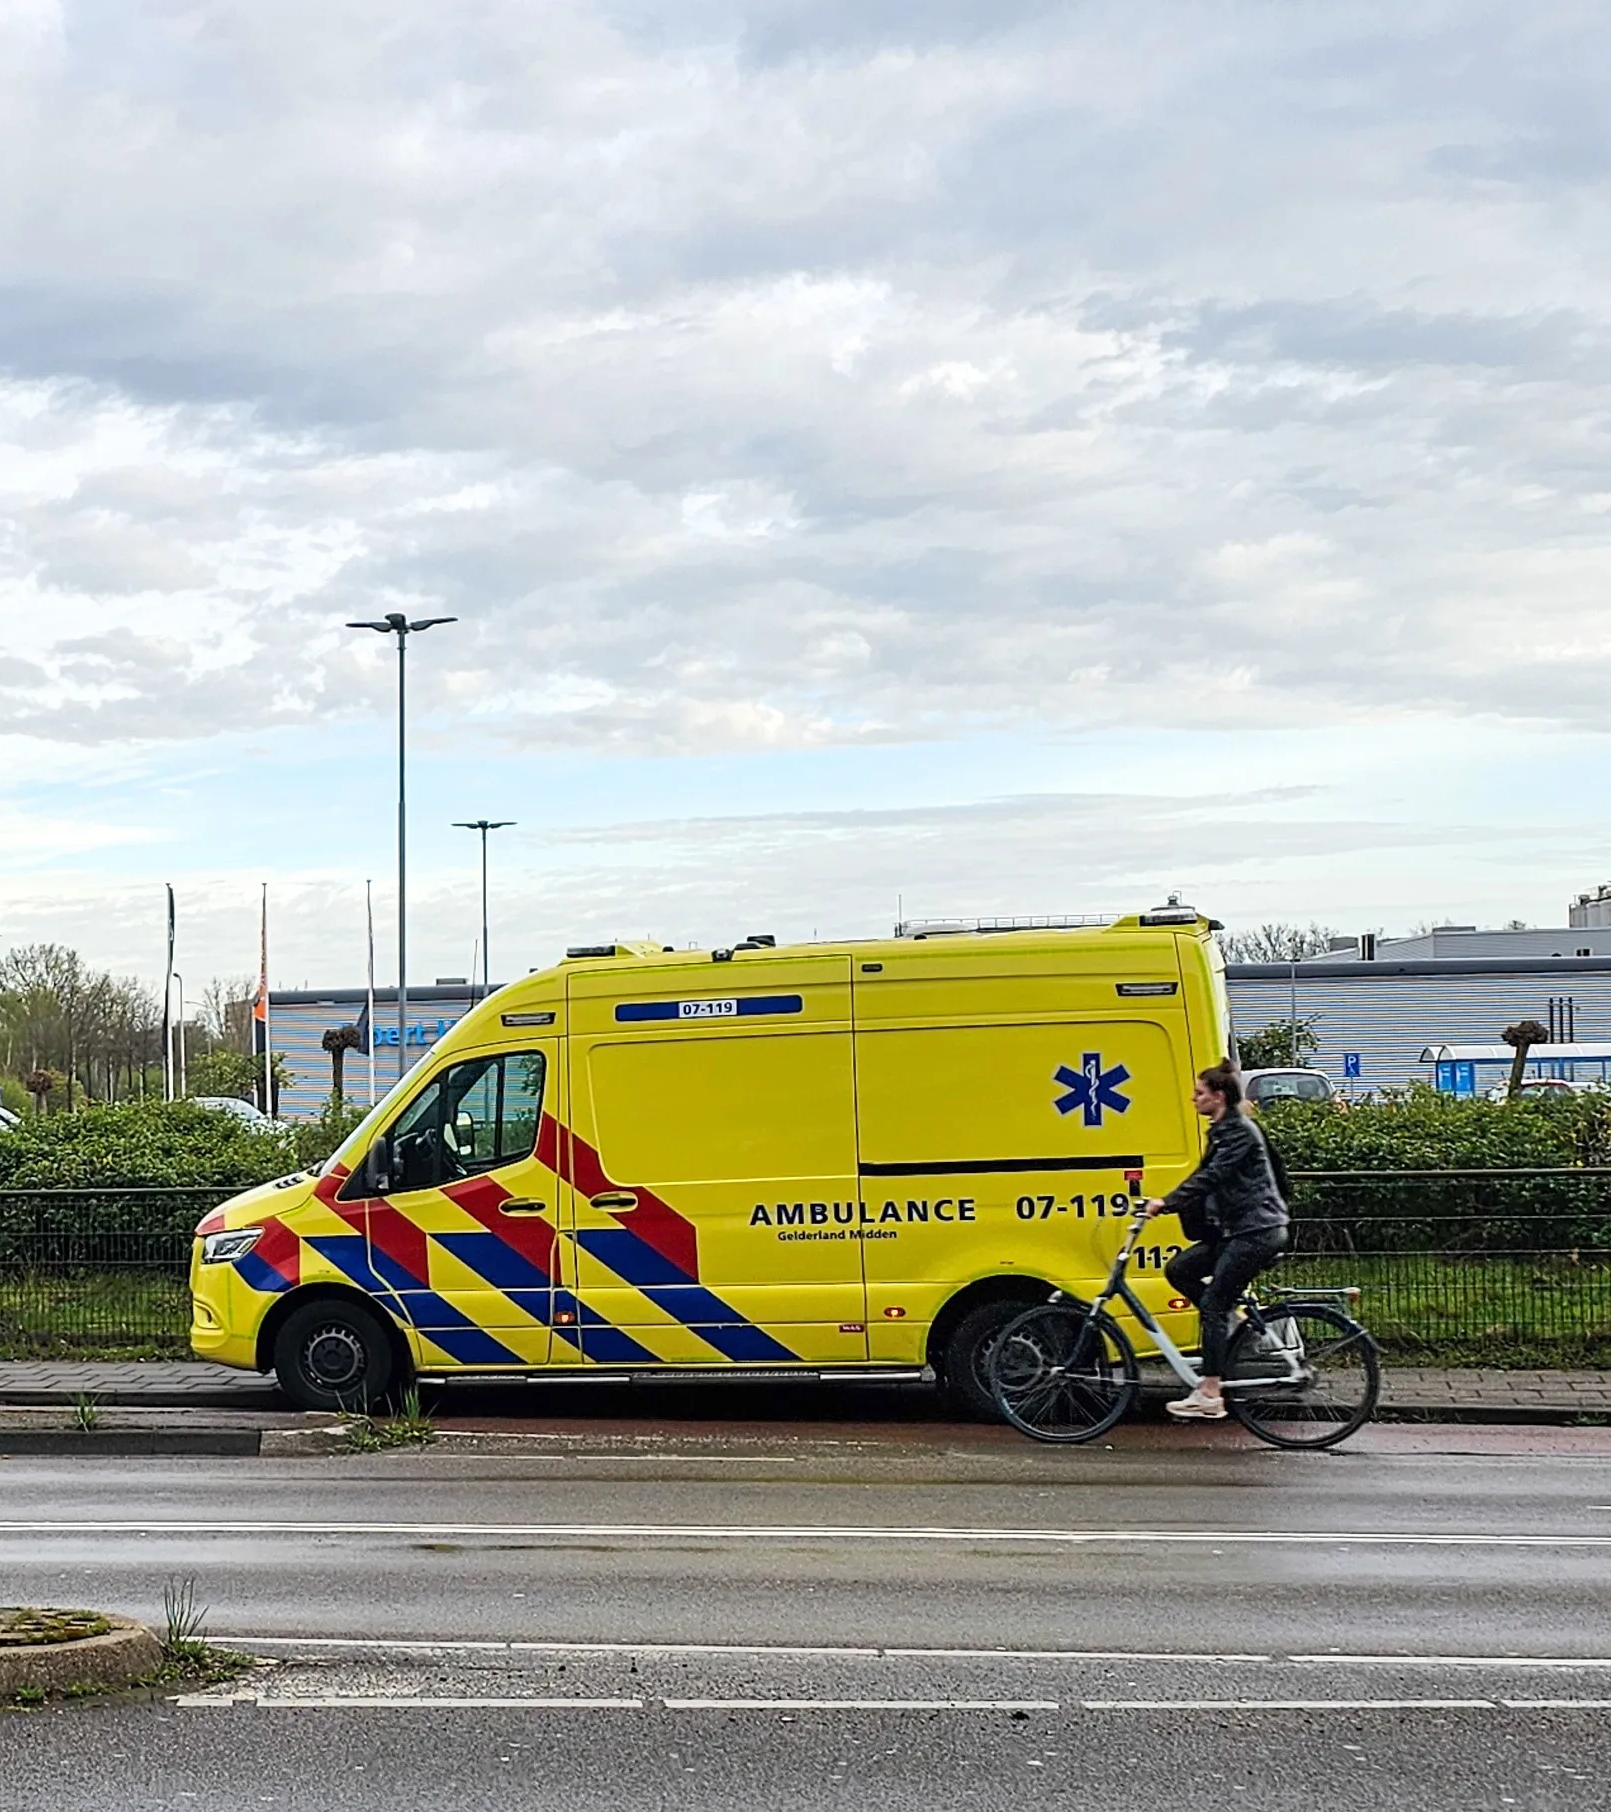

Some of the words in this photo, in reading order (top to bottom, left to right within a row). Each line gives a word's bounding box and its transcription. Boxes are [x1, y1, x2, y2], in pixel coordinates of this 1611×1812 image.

[682, 1001, 733, 1015] 07-119
[750, 1199, 976, 1226] AMBULANCE
[1016, 1193, 1129, 1220] 07-119
[777, 1230, 846, 1241] Gelderland
[849, 1229, 898, 1239] Midden
